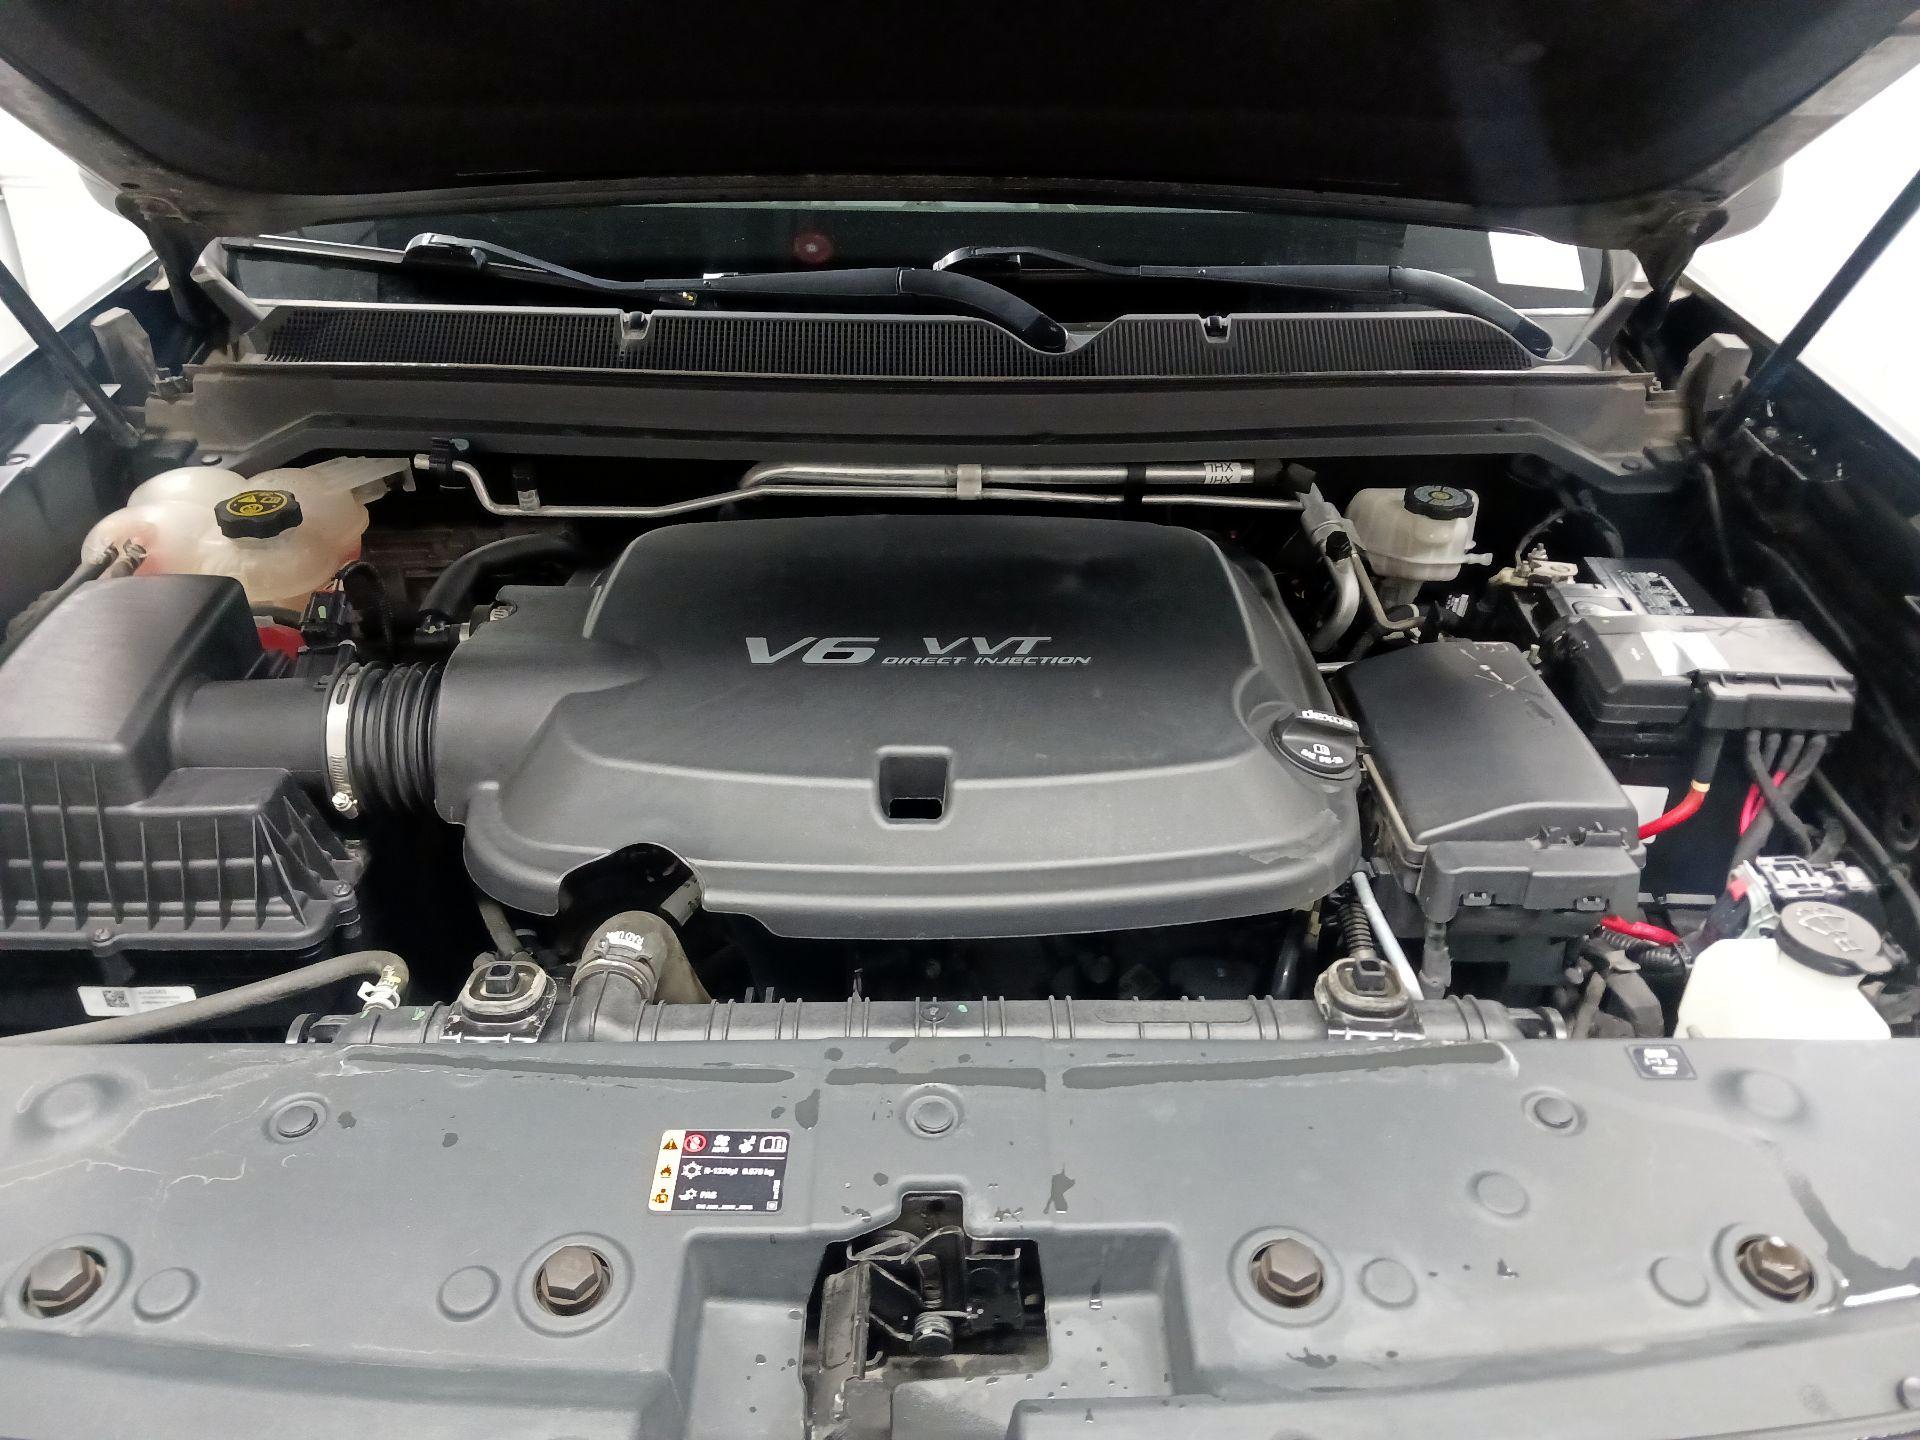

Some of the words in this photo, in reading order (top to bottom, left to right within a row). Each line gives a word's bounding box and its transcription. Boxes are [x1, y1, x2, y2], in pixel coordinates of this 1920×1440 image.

[745, 637, 880, 664] V6
[923, 637, 1052, 655] VVT
[881, 656, 967, 665] DIRECT
[973, 656, 1092, 665] INJECTION
